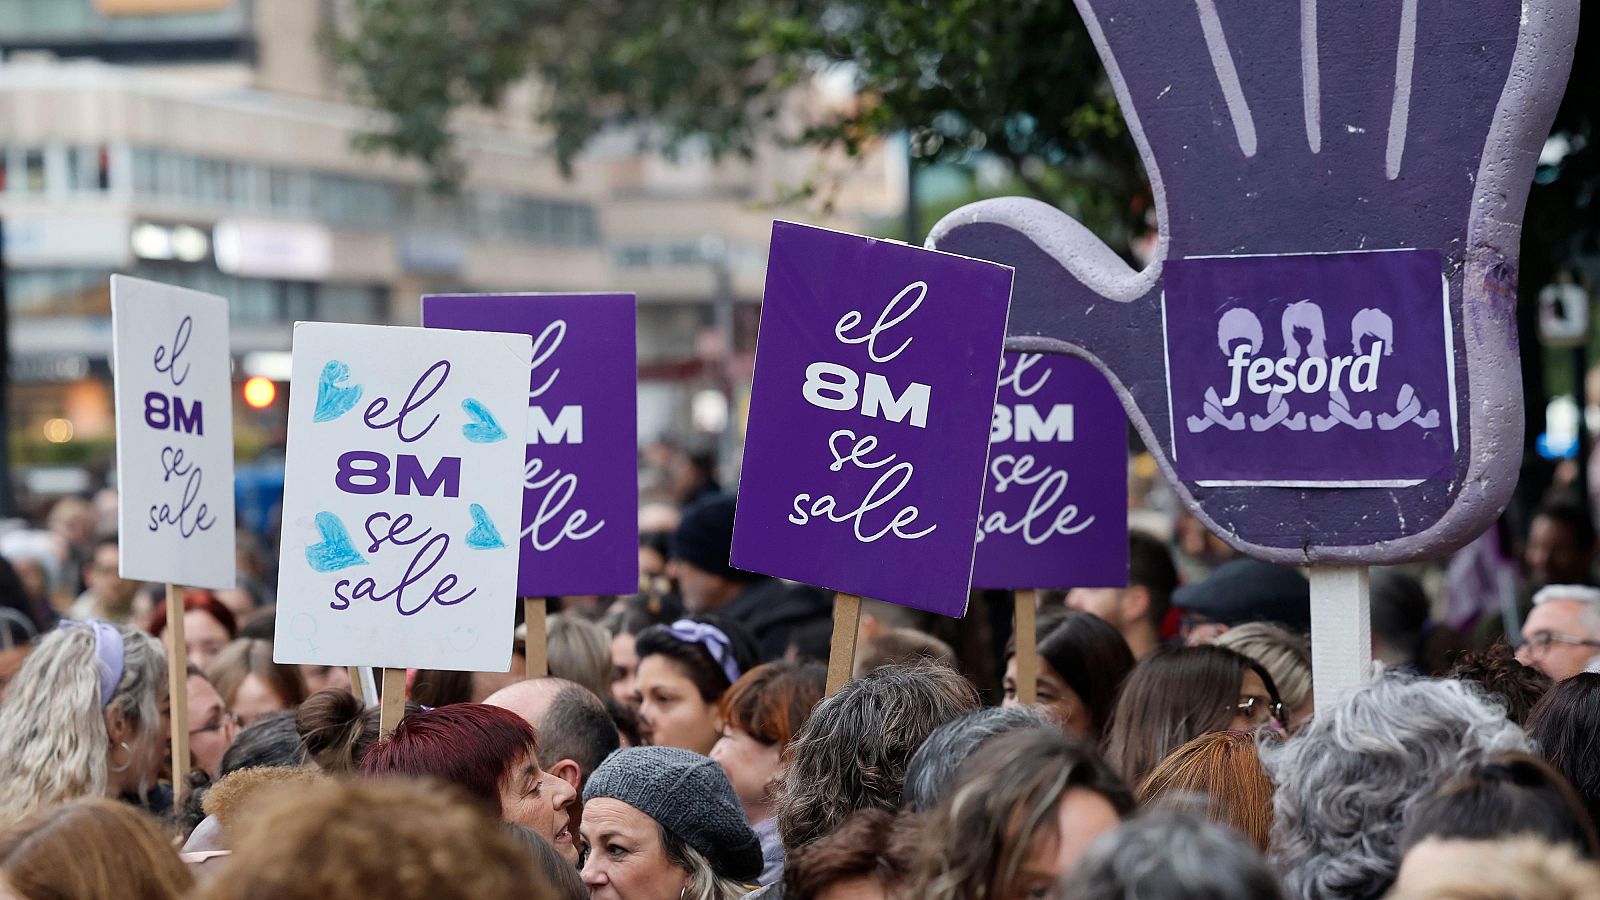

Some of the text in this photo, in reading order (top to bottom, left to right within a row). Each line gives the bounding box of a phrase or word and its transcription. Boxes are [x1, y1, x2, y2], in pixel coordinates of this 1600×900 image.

[153, 315, 192, 387] el
[835, 280, 928, 363] el
[530, 319, 567, 398] l
[1222, 341, 1384, 408] fesord
[144, 390, 204, 437] 8M
[363, 359, 451, 443] el
[526, 405, 584, 445] M
[803, 362, 932, 429] 8M
[160, 445, 193, 483] se
[335, 450, 462, 499] 8M
[524, 457, 561, 490] e
[828, 429, 897, 472] se
[990, 454, 1052, 493] se
[149, 467, 217, 540] sale
[365, 511, 433, 554] se
[520, 473, 605, 552] le
[788, 461, 937, 543] sale
[330, 532, 477, 617] sale
